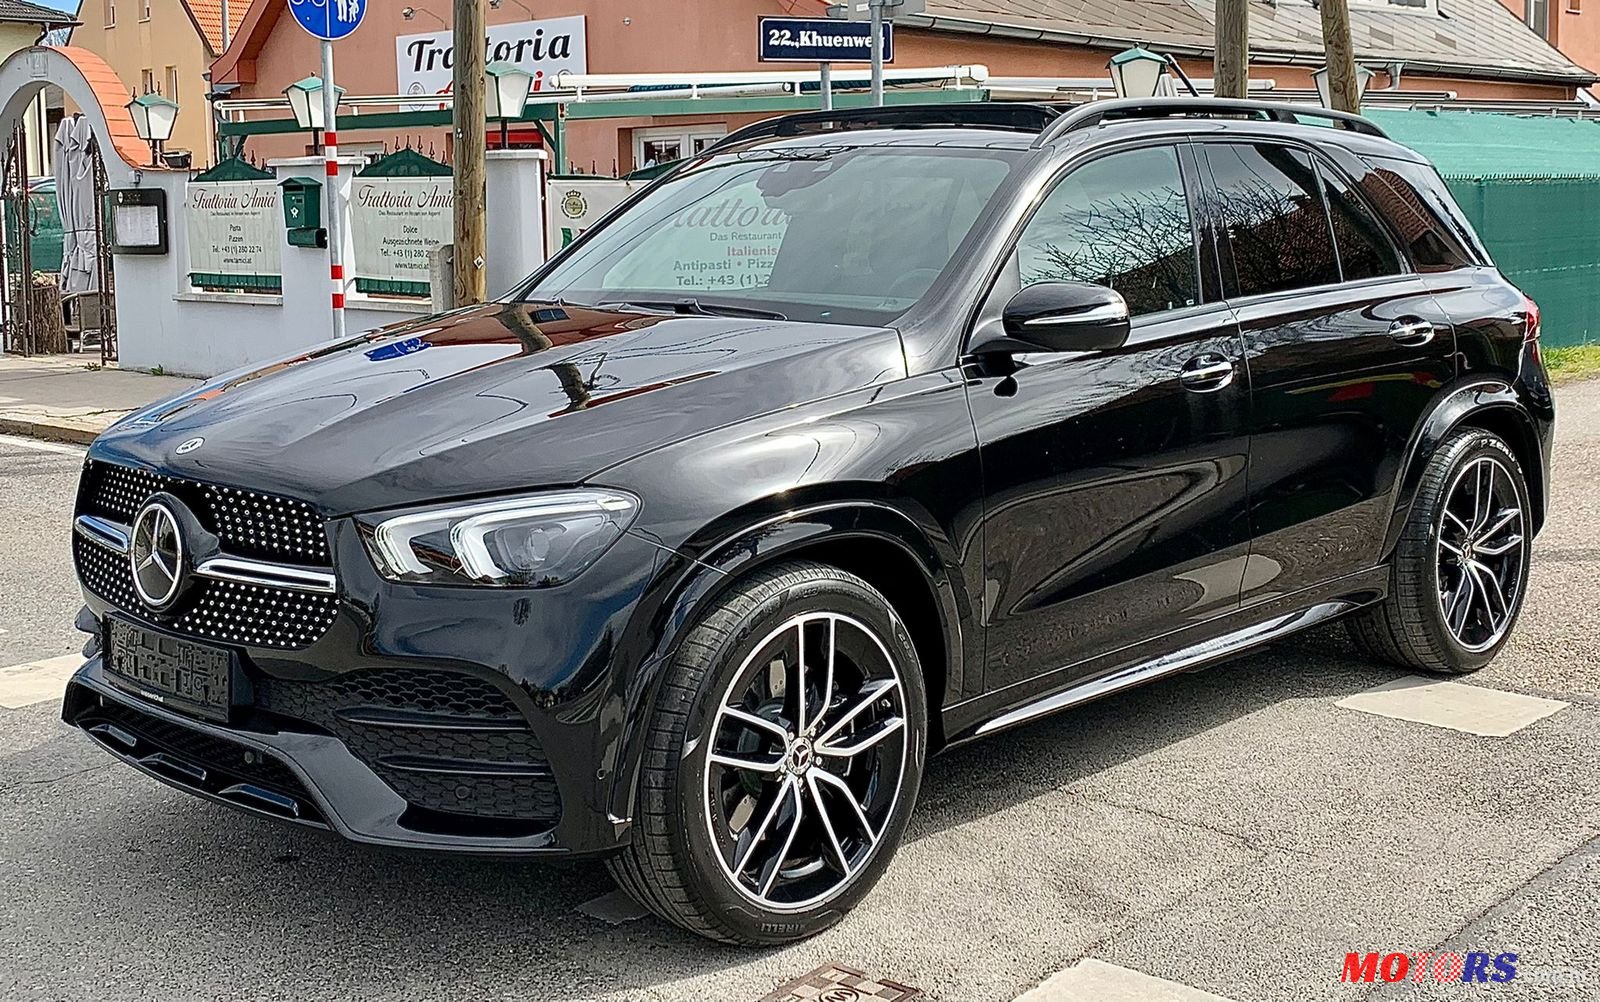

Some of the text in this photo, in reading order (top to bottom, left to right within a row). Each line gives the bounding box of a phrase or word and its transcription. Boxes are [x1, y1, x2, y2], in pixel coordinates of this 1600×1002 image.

[192, 187, 277, 209] Trattoria Amici
[358, 184, 454, 208] Trattoria Amic
[402, 225, 418, 234] Dolce
[709, 231, 782, 242] Das Restaurant
[727, 246, 777, 257] Italienis
[673, 258, 773, 273] Antipasti Pizz
[676, 276, 704, 286] Tel.:
[707, 274, 735, 285] +43
[760, 922, 805, 933] IRELLI
